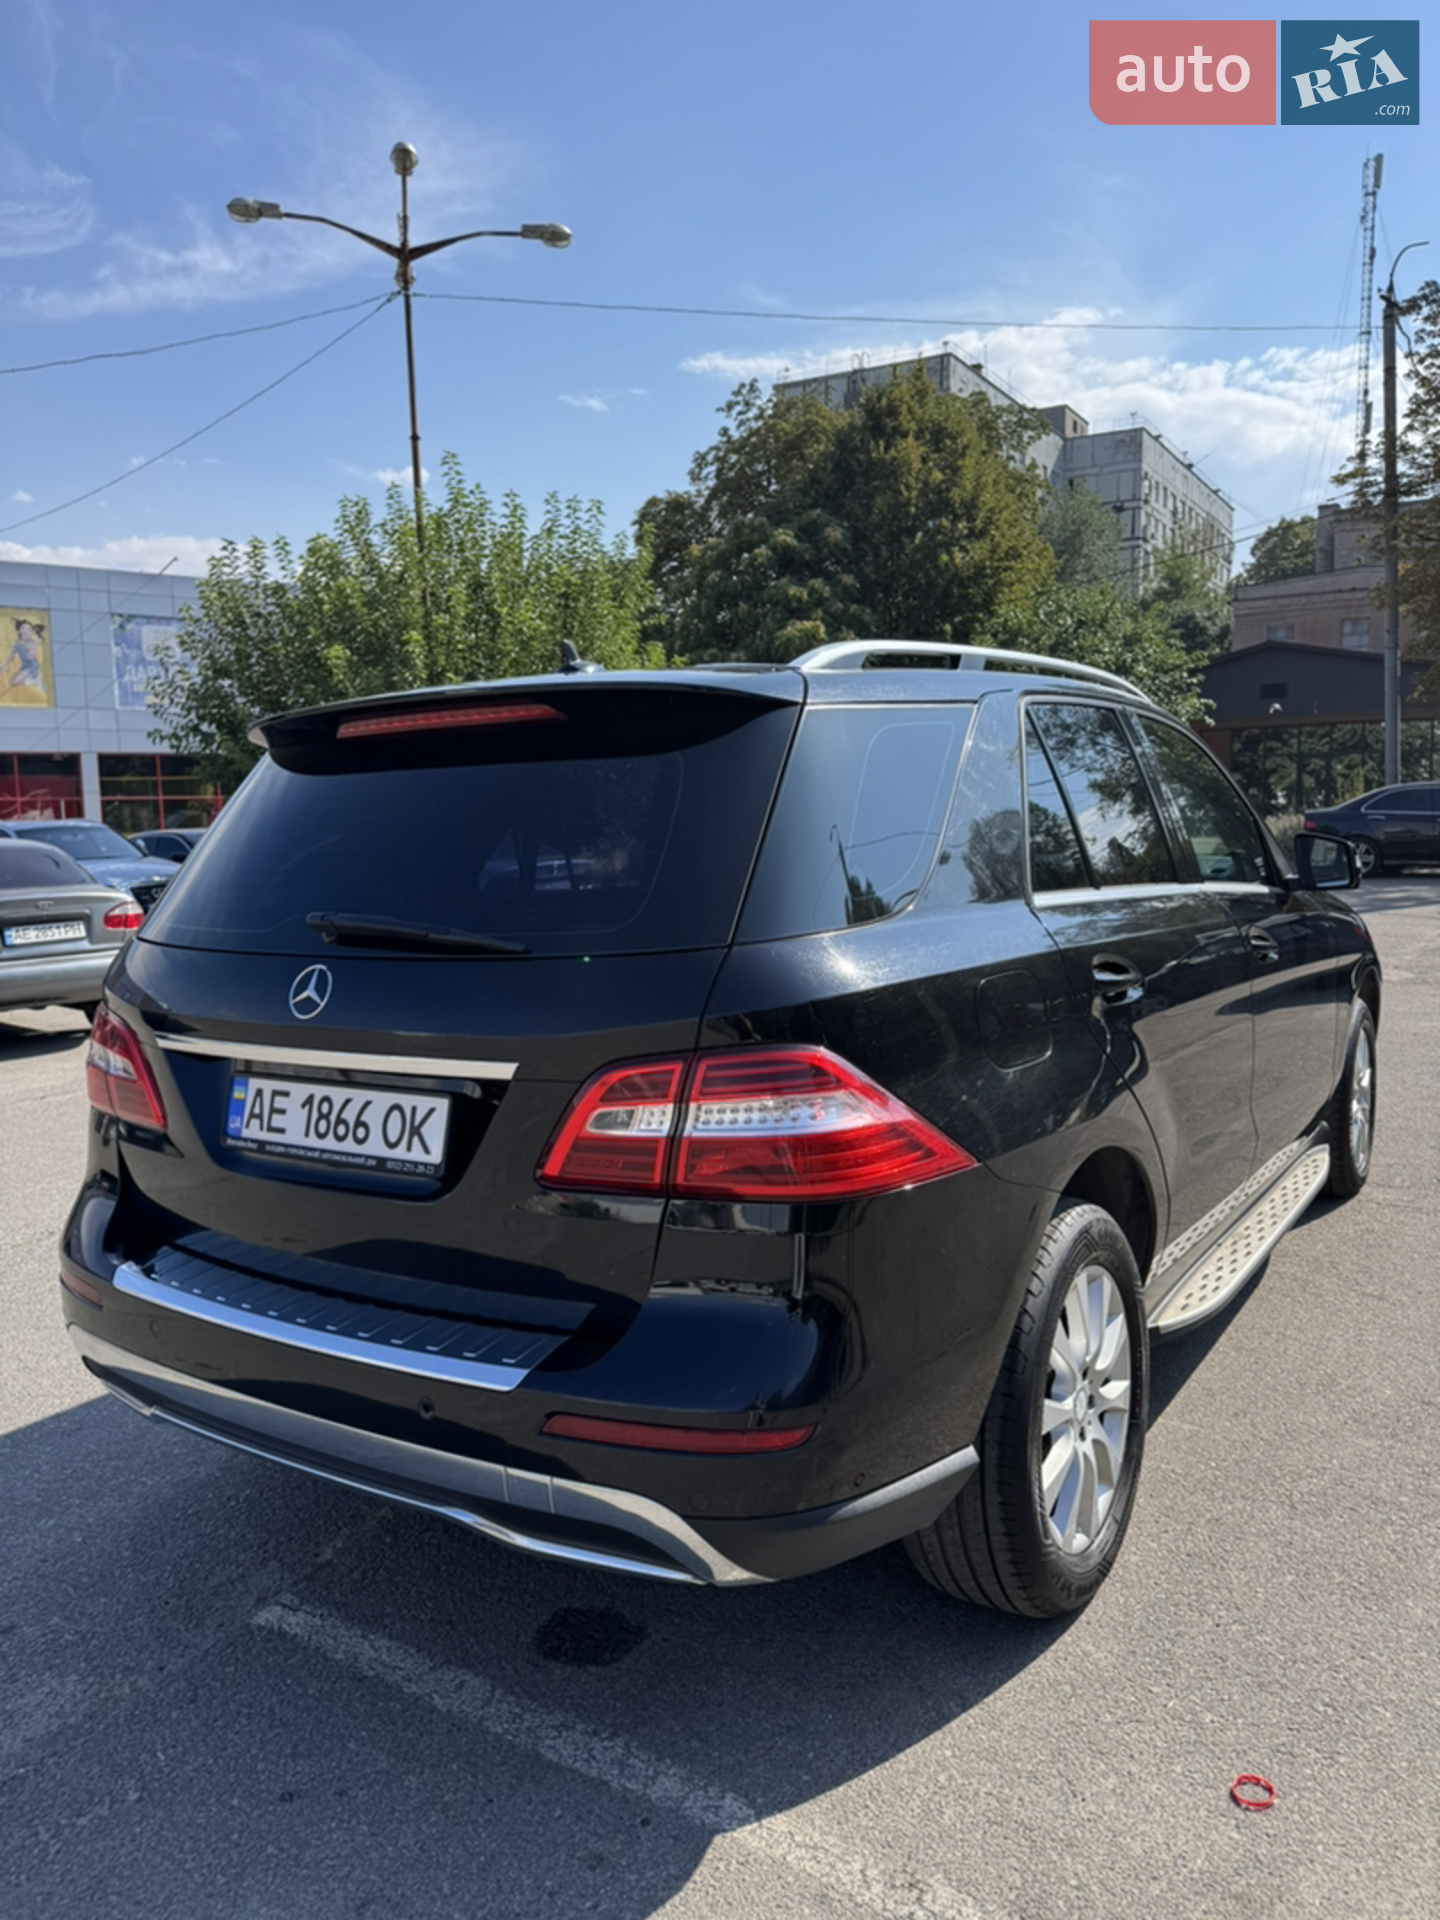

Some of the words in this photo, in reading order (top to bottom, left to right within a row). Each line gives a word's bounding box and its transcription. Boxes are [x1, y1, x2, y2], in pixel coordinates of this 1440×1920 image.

[228, 1114, 241, 1128] UA
[244, 1087, 290, 1135] AE
[301, 1093, 373, 1146] 1866
[382, 1102, 437, 1155] OK
